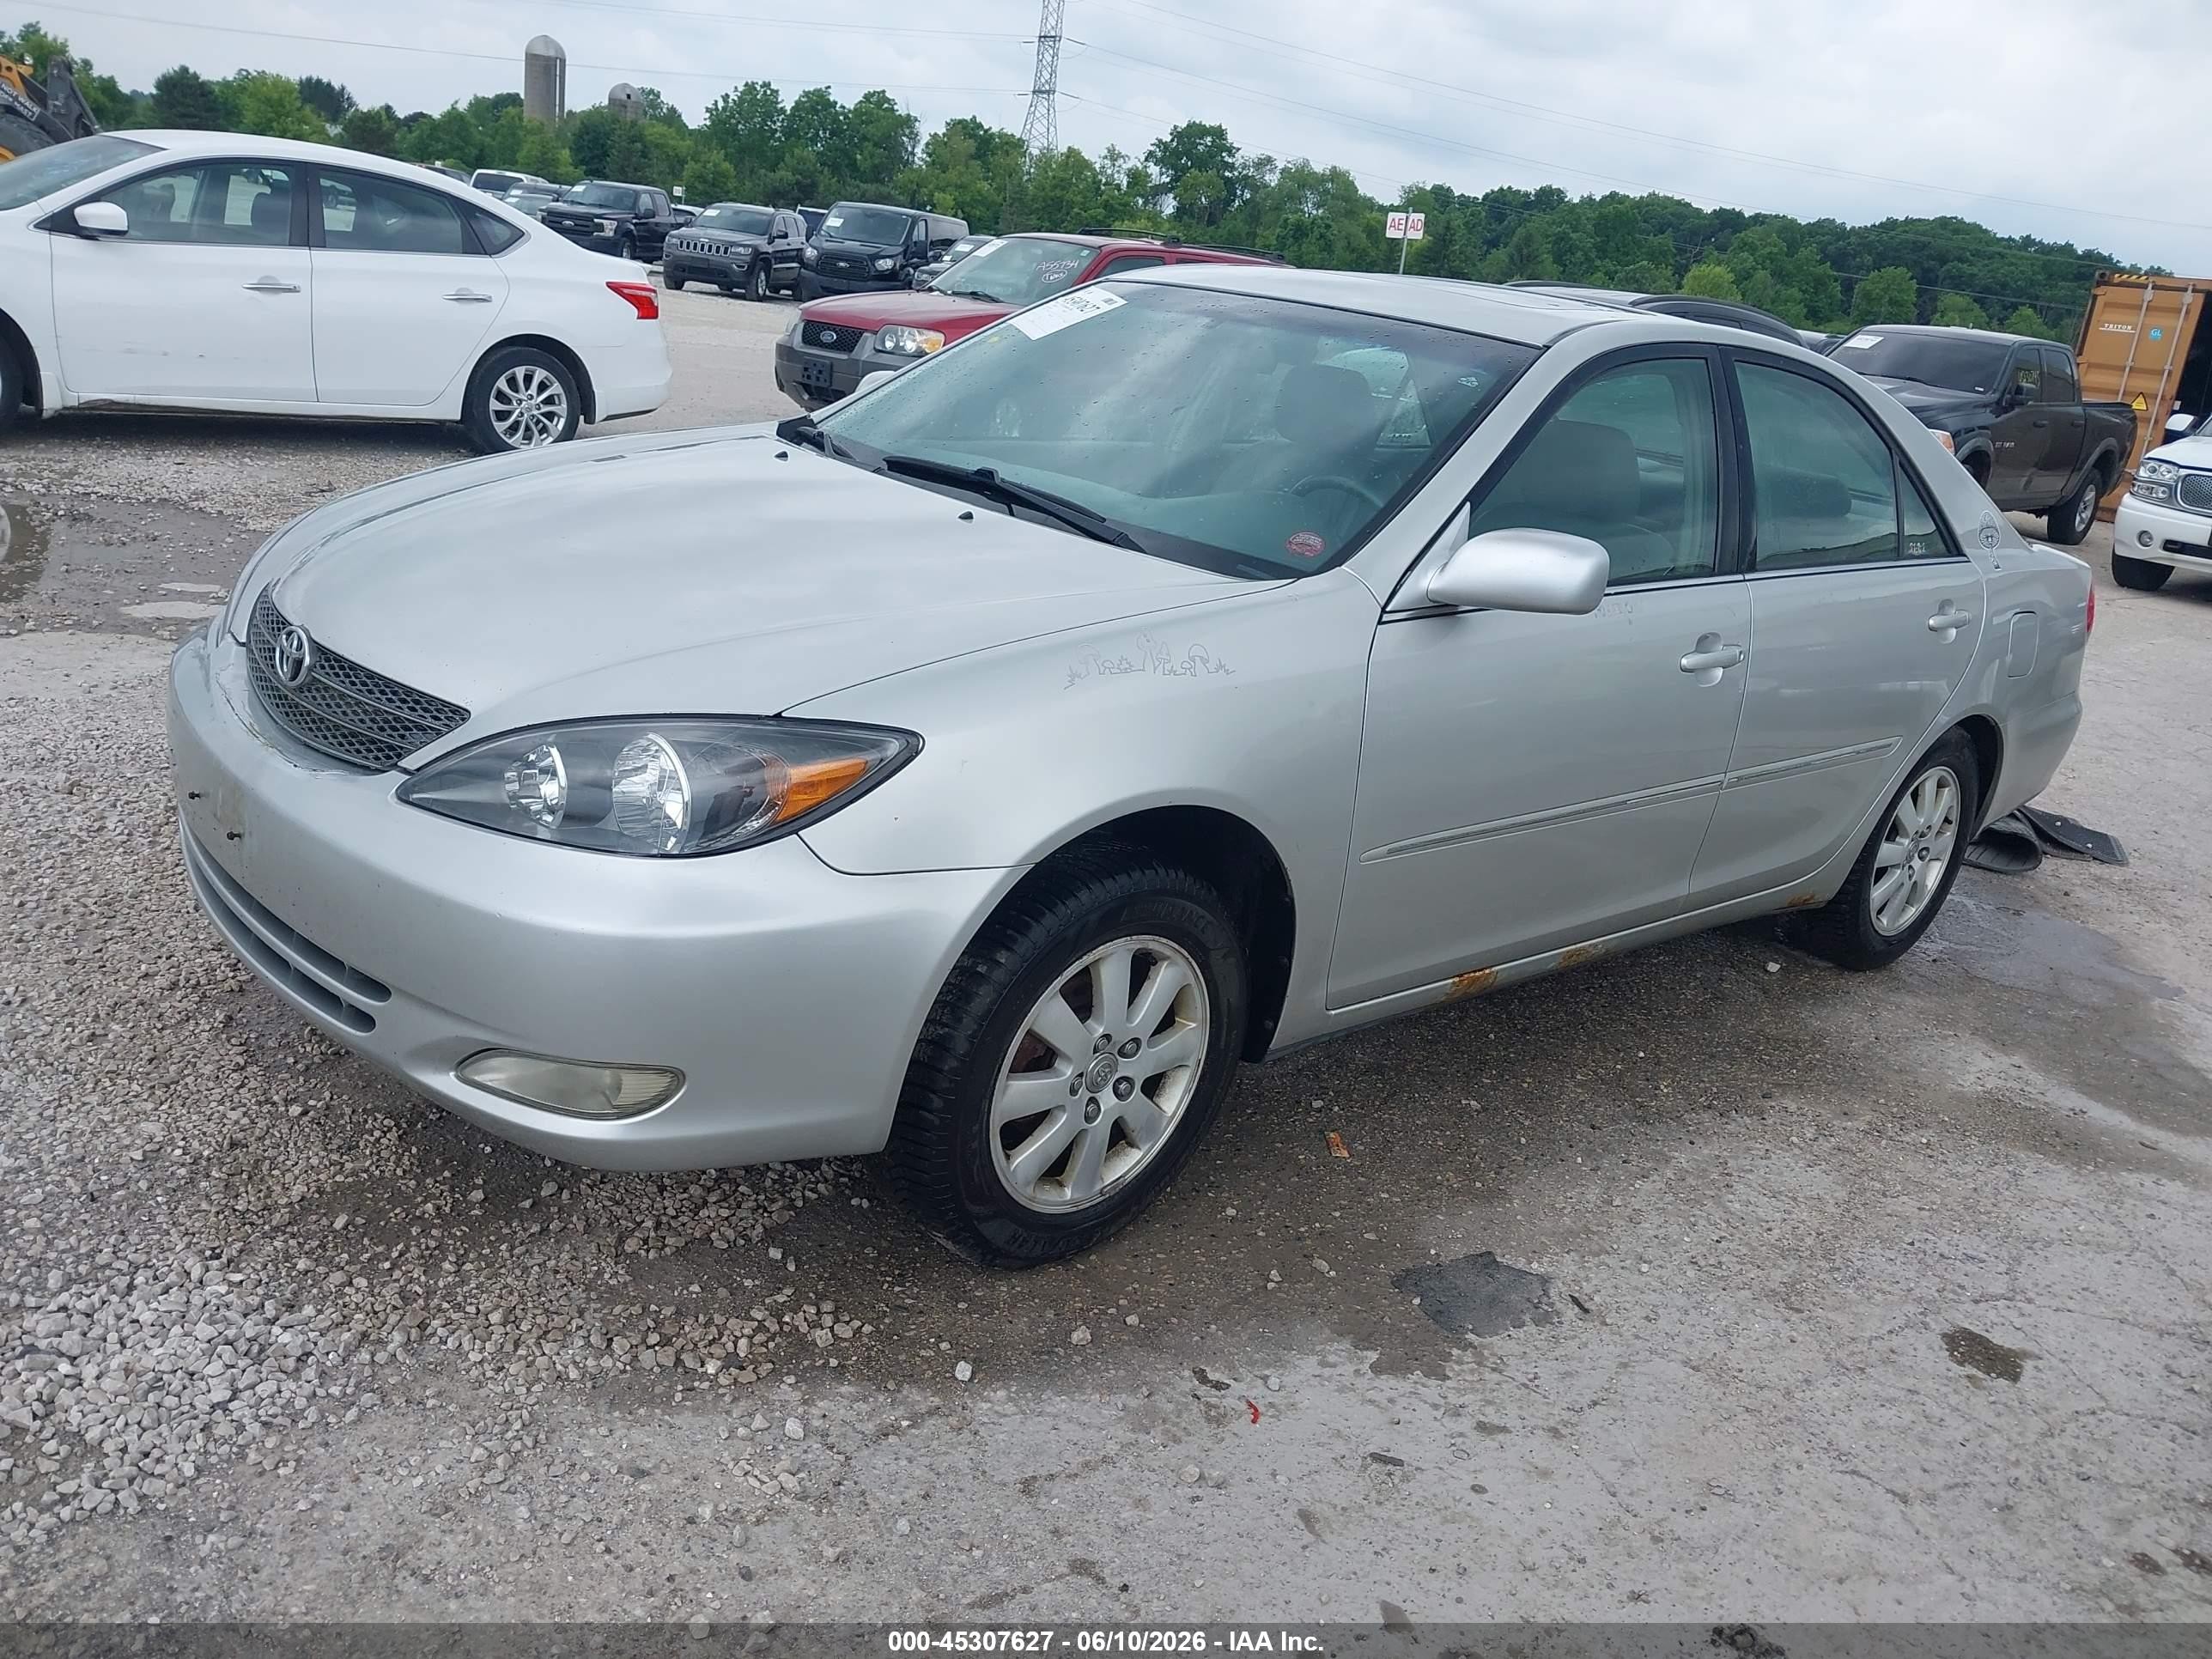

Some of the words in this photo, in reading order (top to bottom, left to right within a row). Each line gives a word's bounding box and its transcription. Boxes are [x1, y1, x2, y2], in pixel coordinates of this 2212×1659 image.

[1389, 218, 1404, 231] AE
[1408, 218, 1424, 232] AD
[2150, 328, 2162, 337] GL
